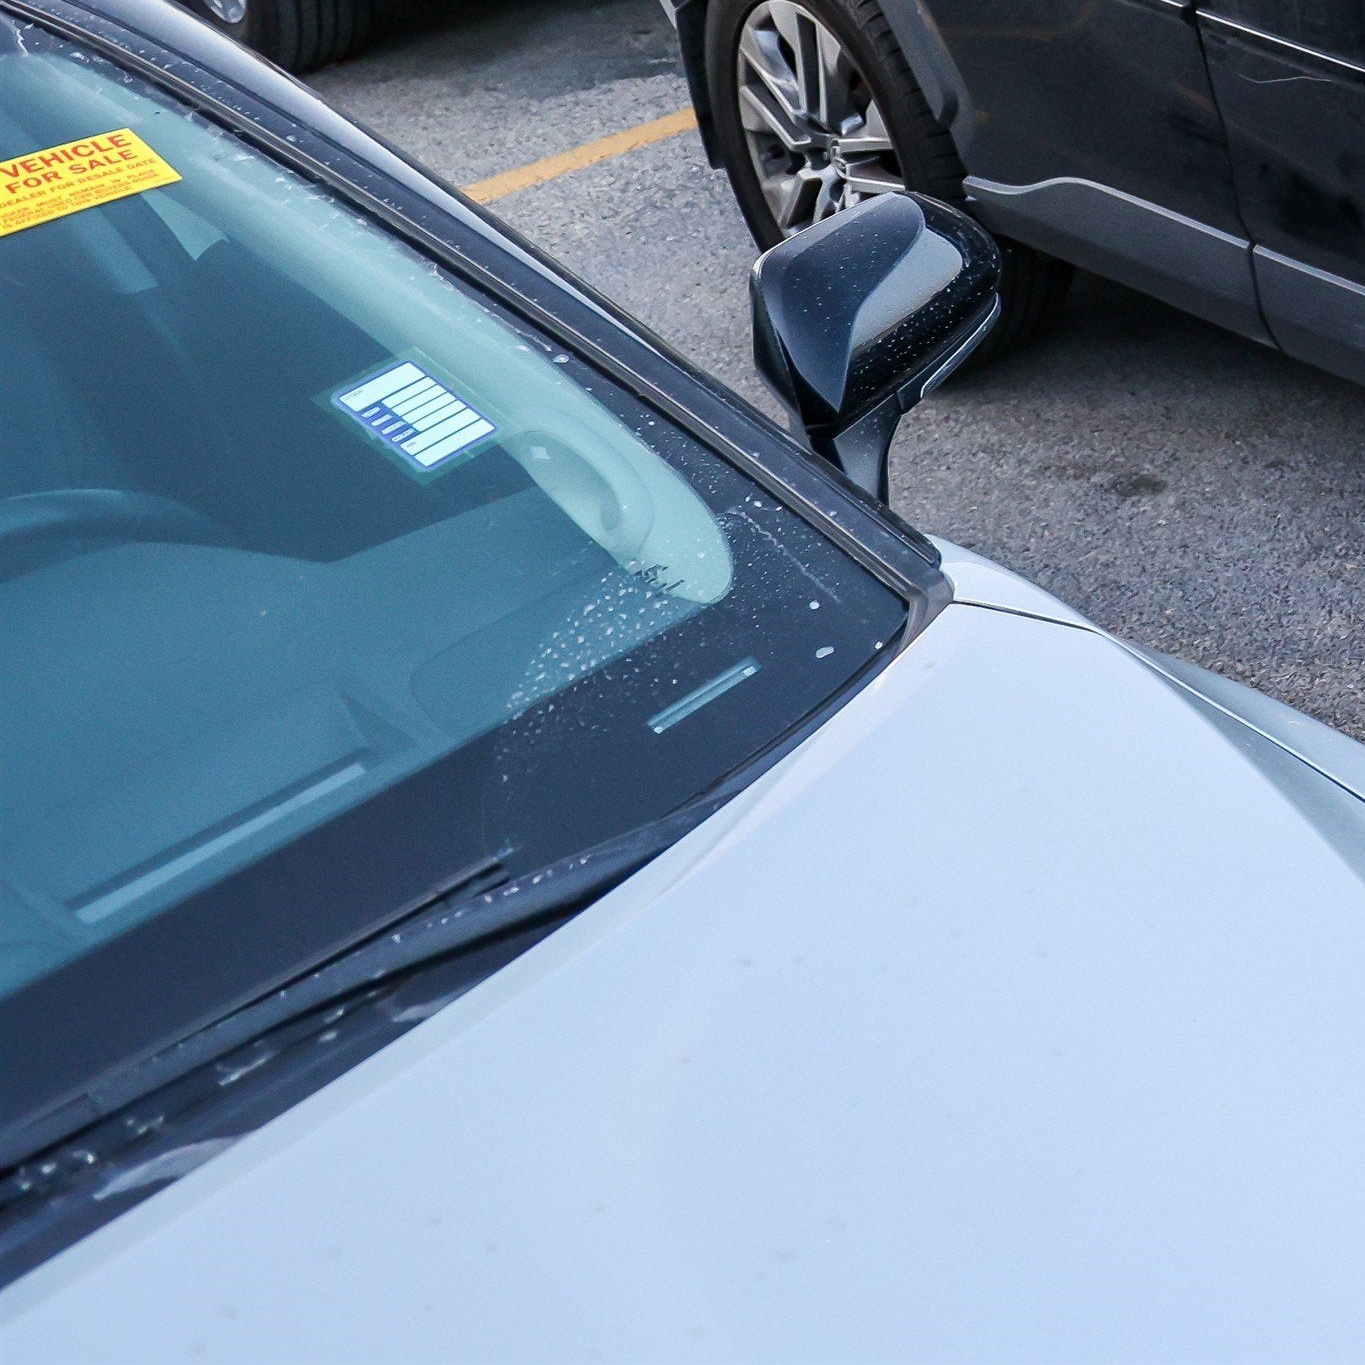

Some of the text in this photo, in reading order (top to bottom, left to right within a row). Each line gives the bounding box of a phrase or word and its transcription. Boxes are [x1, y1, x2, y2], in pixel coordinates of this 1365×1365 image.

[0, 134, 132, 178] VEHICLE
[5, 149, 139, 194] FOR SALE
